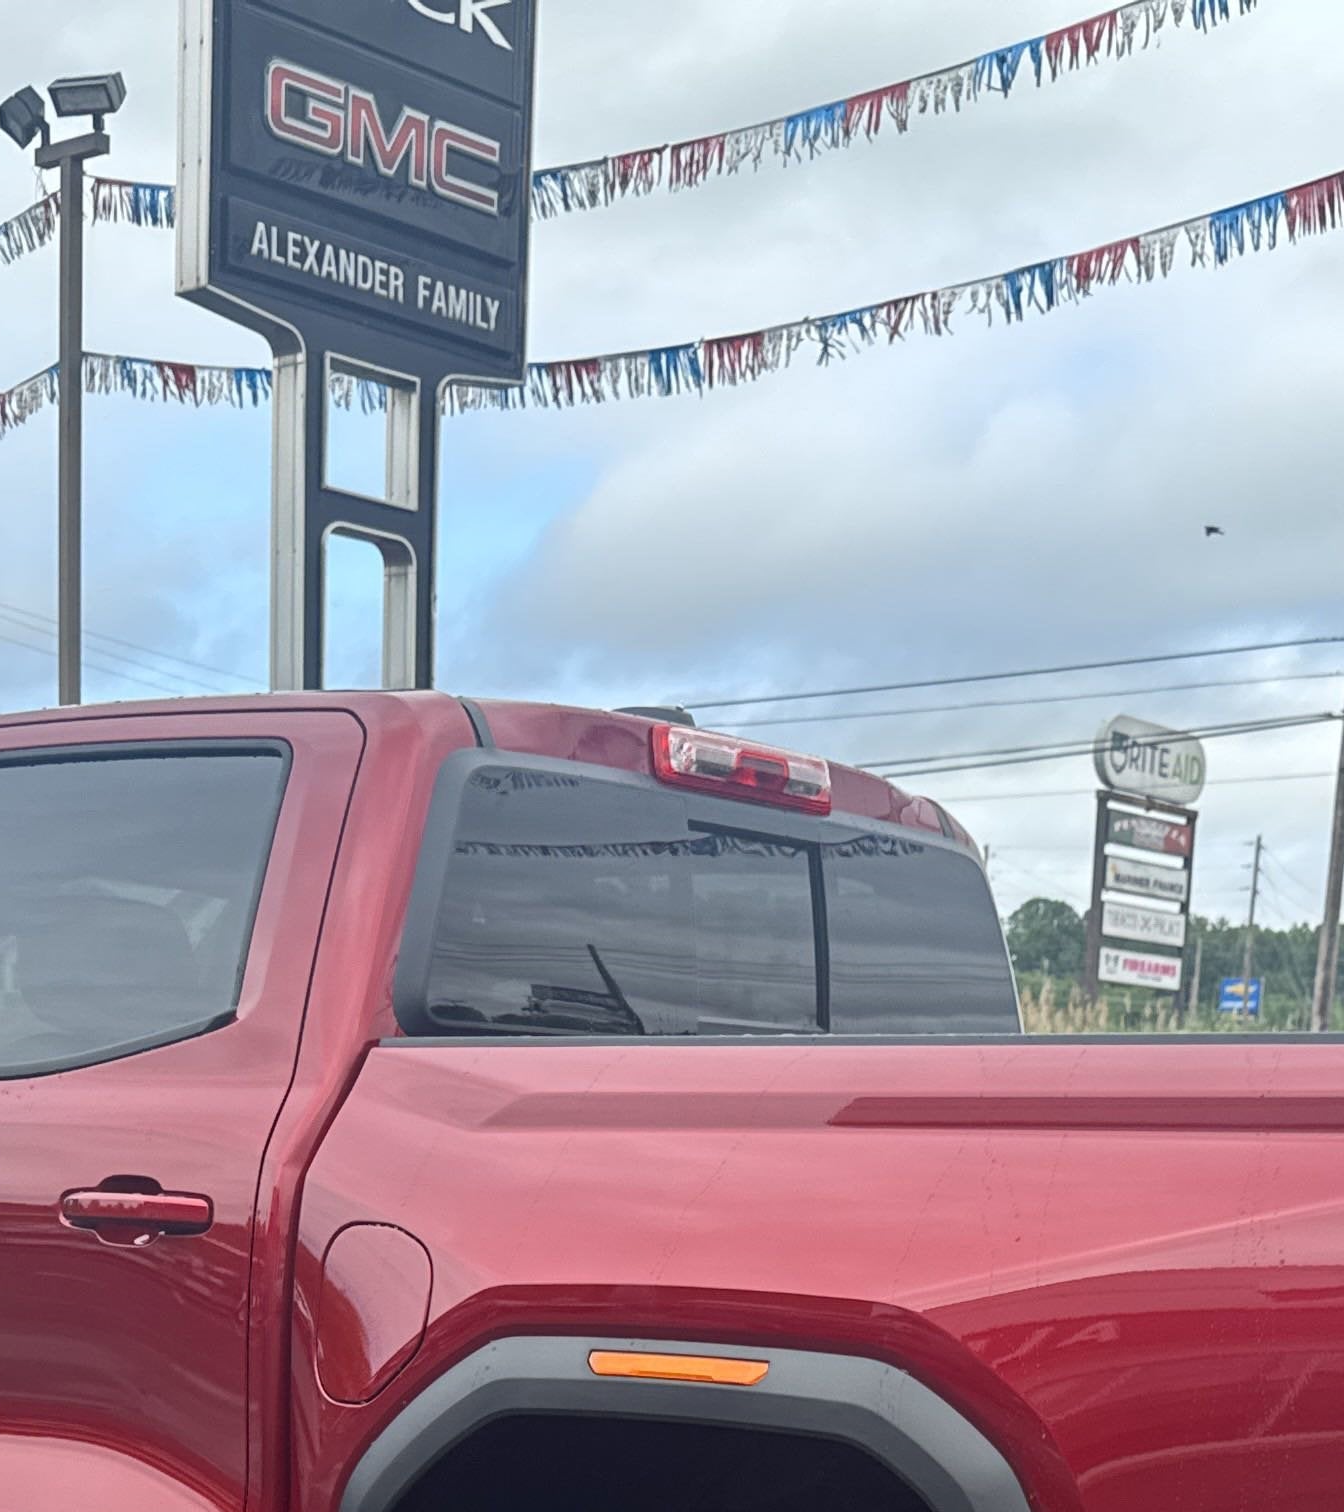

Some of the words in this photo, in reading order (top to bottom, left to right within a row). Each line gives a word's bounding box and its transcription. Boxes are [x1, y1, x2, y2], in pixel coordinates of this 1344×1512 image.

[266, 57, 501, 217] GMC
[251, 221, 405, 304] ALEXANDER
[417, 275, 501, 331] FAMILY
[1128, 740, 1170, 778] RITE
[1172, 752, 1201, 785] AID
